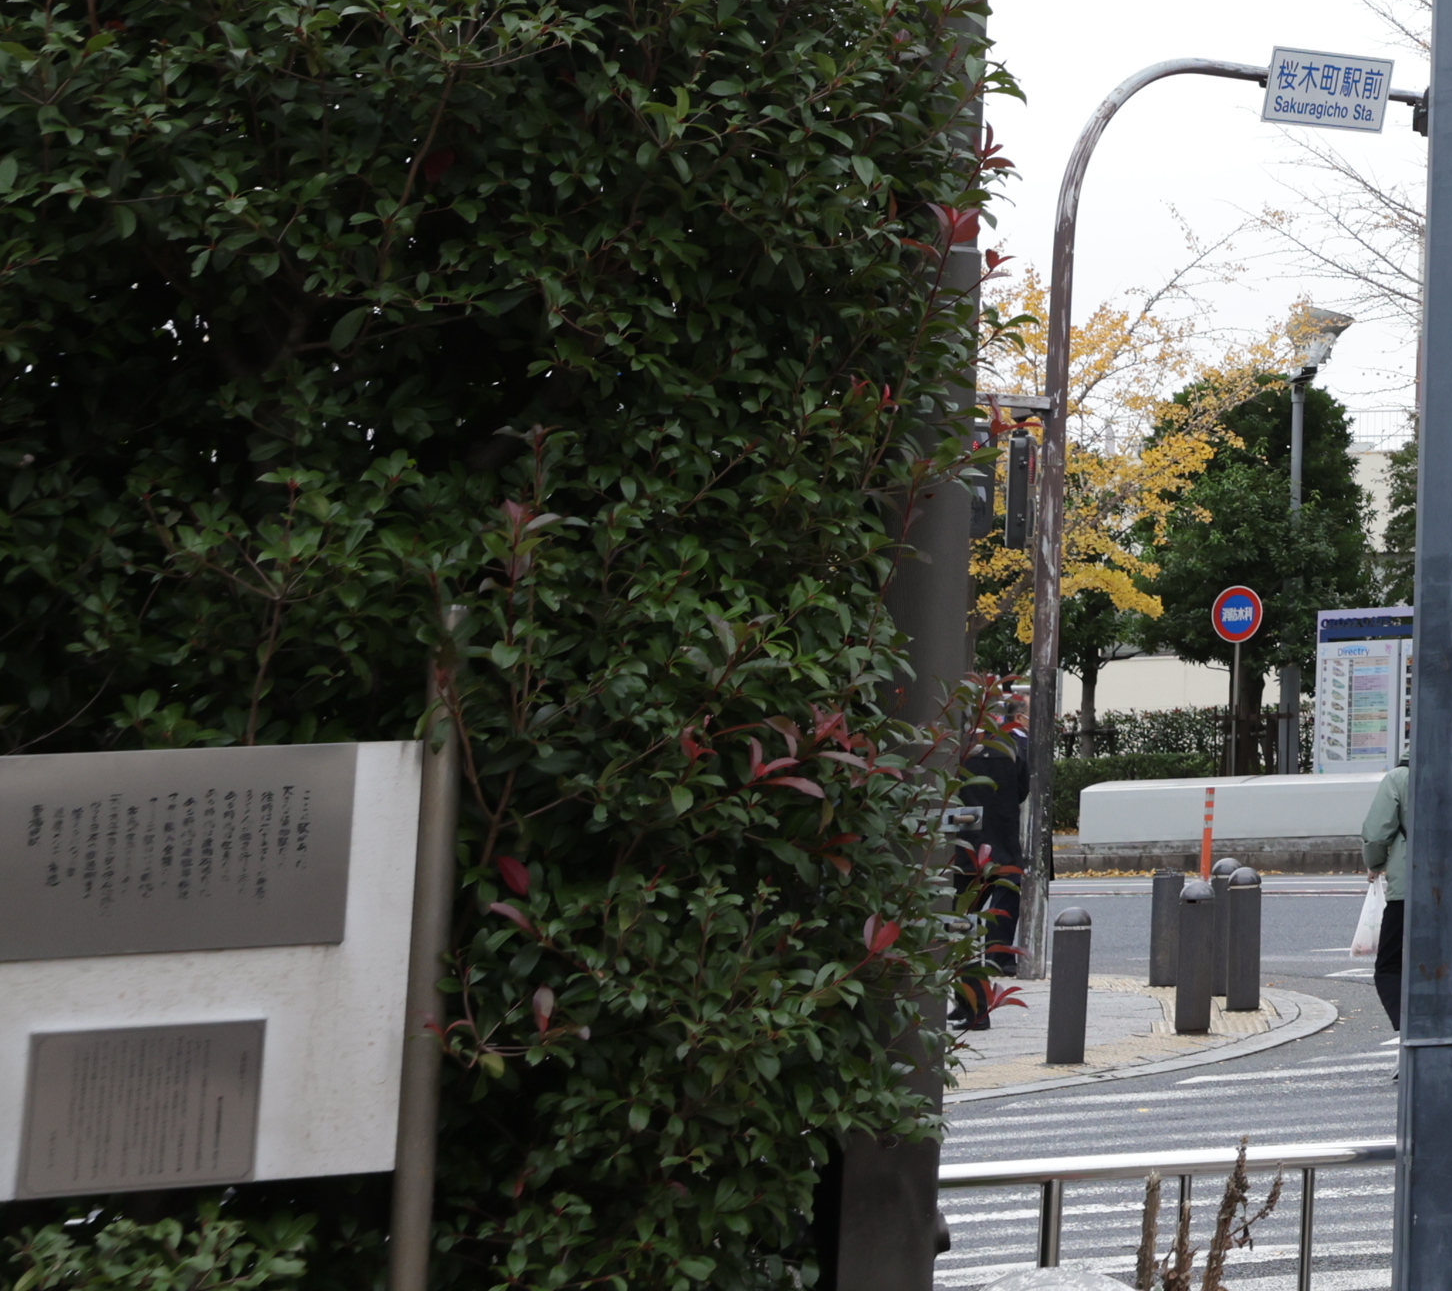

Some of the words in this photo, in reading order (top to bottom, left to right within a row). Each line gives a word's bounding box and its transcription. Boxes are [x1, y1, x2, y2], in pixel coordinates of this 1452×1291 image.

[1277, 58, 1384, 101] 桜木町駅前
[1273, 96, 1348, 122] Sakuragicho
[1354, 104, 1375, 122] Sta.
